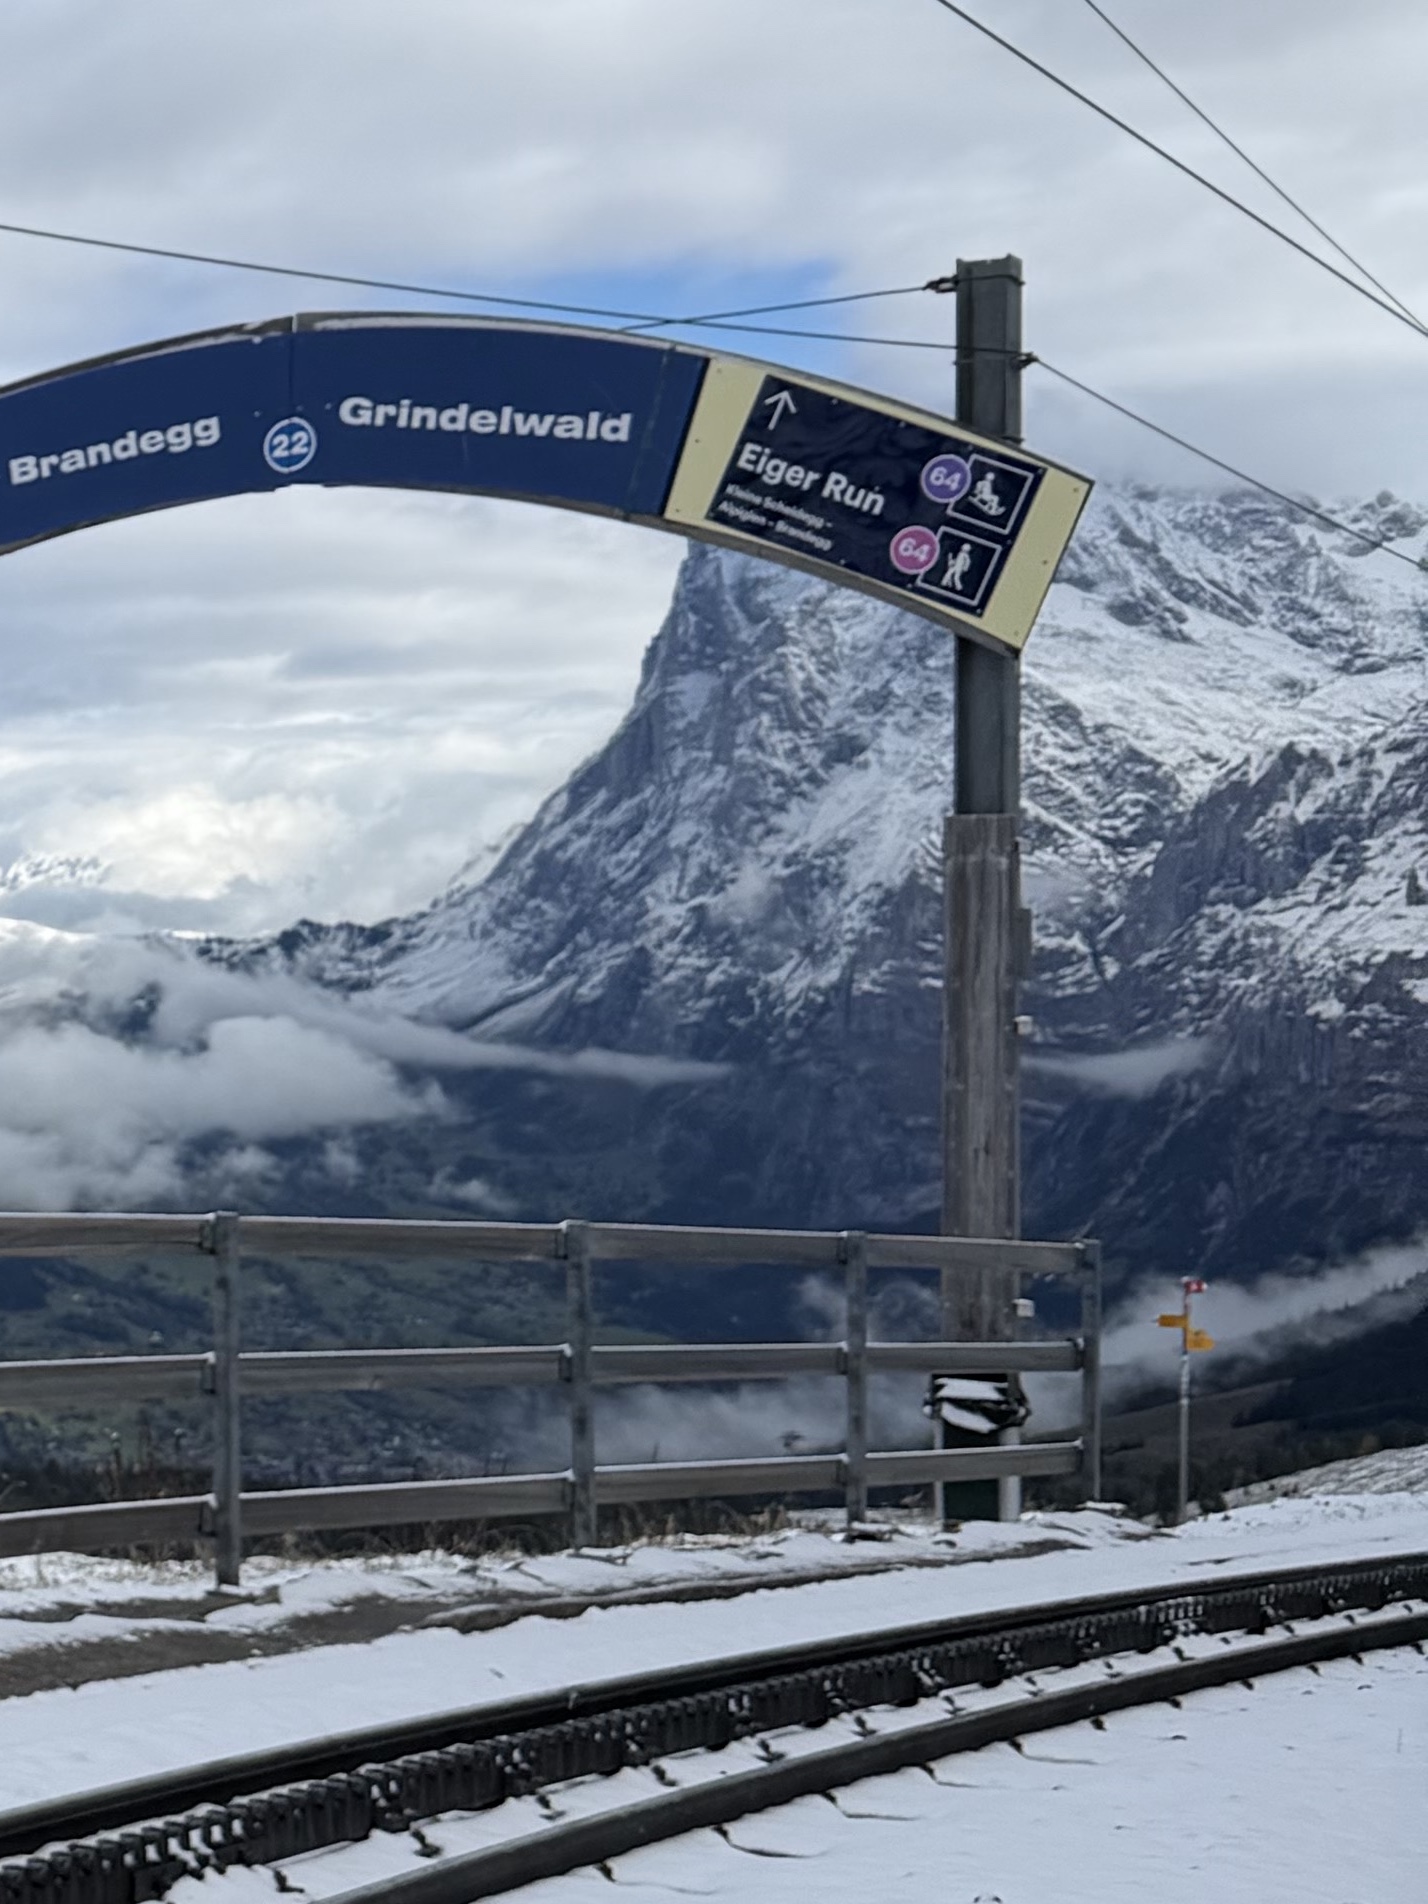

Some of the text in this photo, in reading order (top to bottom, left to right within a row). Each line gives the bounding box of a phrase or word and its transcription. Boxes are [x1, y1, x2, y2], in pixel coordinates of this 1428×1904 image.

[338, 396, 633, 442] Grindelwald
[8, 415, 221, 485] Brandegg
[271, 431, 310, 458] 22
[737, 441, 885, 515] Eiger Run
[929, 466, 962, 491] 64
[898, 537, 930, 562] 64
